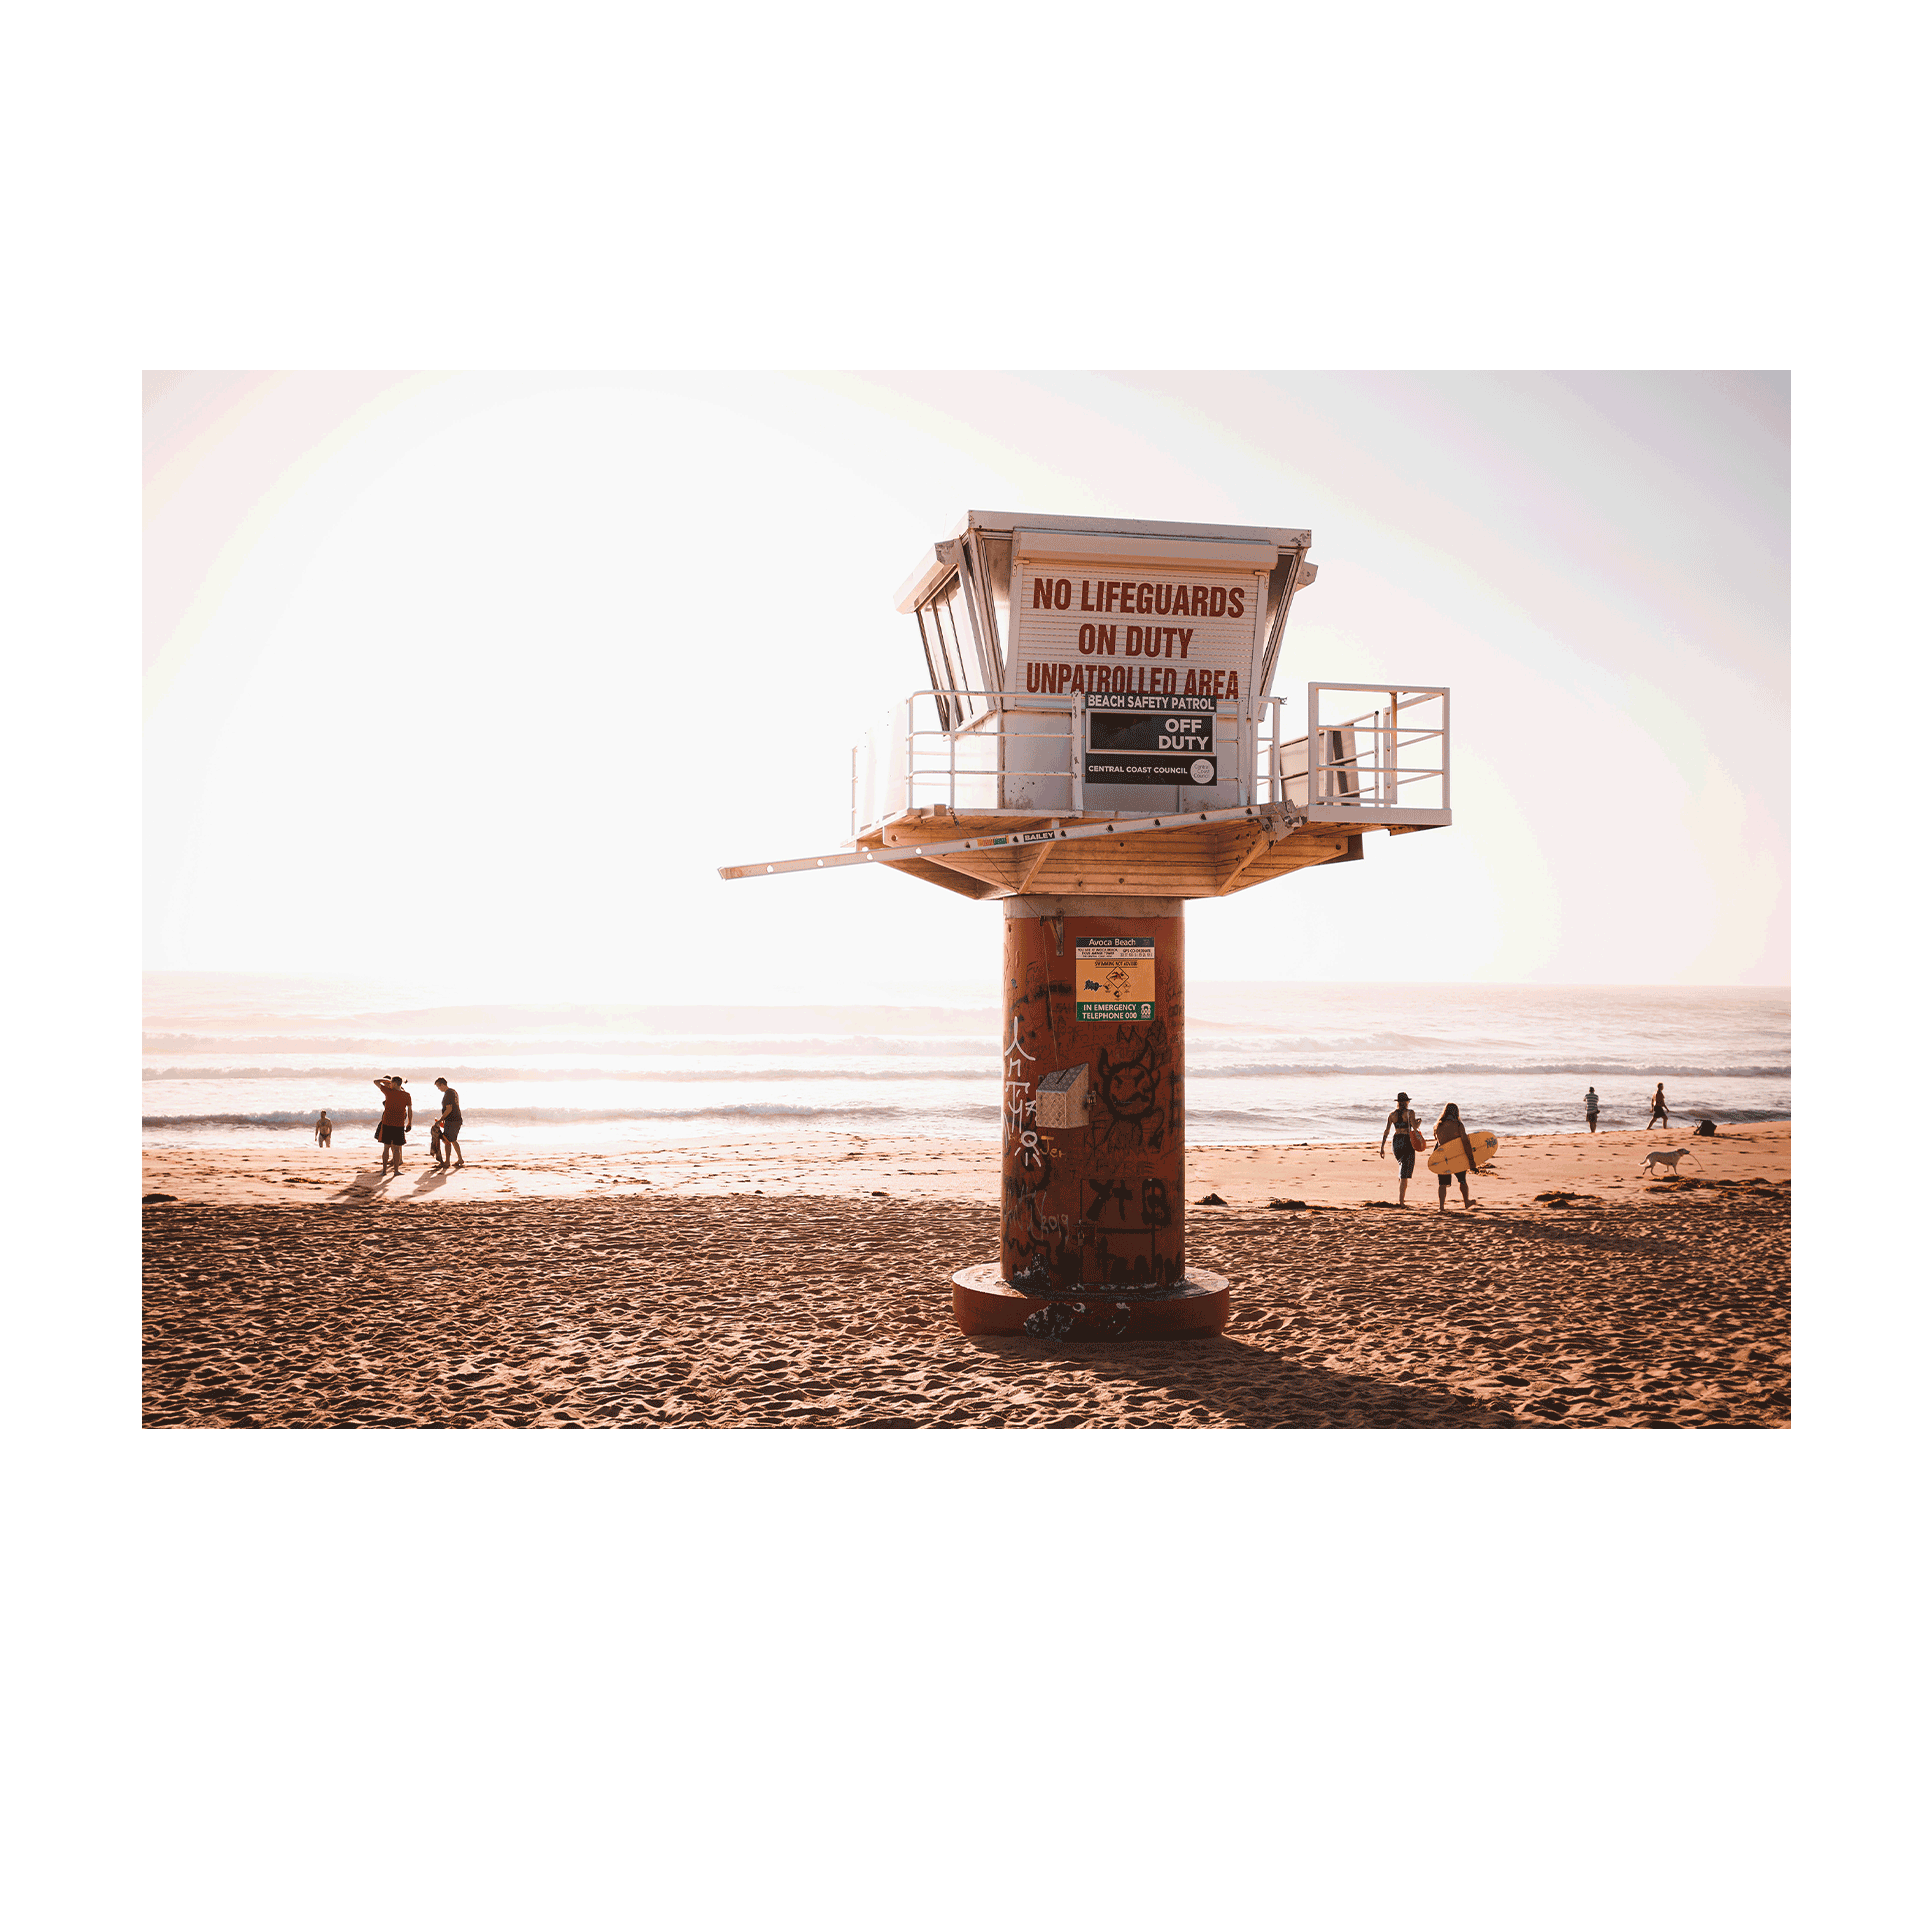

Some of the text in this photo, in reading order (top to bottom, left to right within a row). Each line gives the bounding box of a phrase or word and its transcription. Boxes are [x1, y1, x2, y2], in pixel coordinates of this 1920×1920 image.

[1033, 578, 1245, 618] NO LIFEGUARDS
[1078, 623, 1194, 659] ON DUTY
[1026, 662, 1239, 699] UNPATROLLED AREA
[1088, 695, 1215, 710] BEACH SAFETY PATROL
[1165, 718, 1202, 733] OFF
[1158, 735, 1209, 750] DUTY
[1088, 765, 1125, 773] CENTRAL
[1024, 832, 1054, 841] BAILEY
[1089, 938, 1112, 946] Avoca
[1114, 938, 1136, 946] Beach
[1094, 1003, 1136, 1011] EMERGENCY
